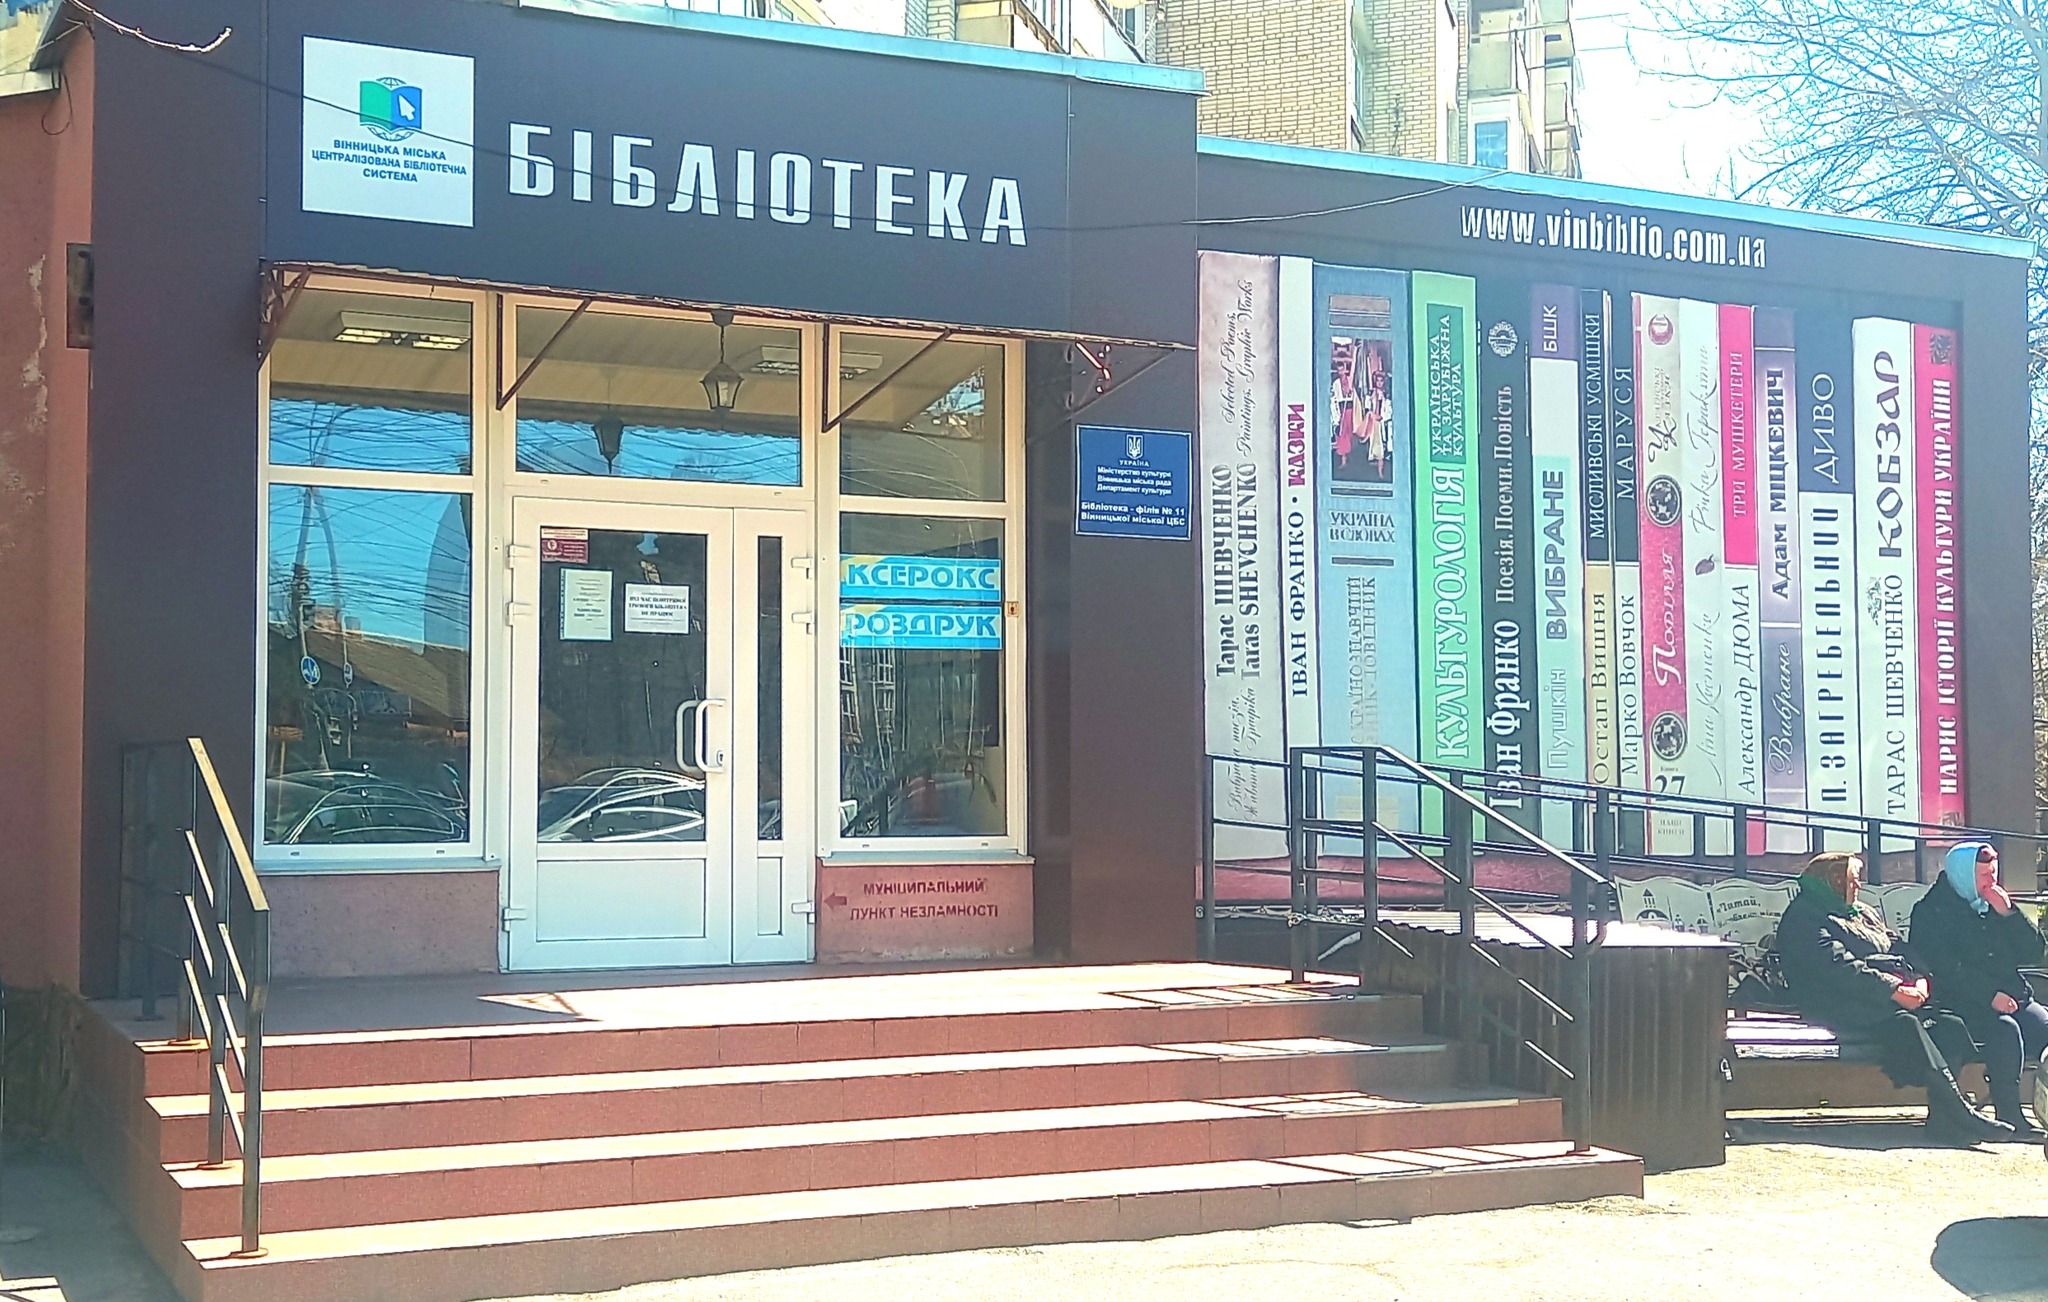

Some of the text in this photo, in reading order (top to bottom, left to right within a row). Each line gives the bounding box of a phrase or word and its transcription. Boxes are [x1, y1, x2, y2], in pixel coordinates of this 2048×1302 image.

[311, 150, 467, 176] ЦЕНТРАЛІЗОВАНА БІБЛІОТЕЧНА
[333, 139, 447, 161] ВІННИЦЬКА МІСЬКА
[363, 168, 418, 183] СИСТЕМА
[507, 120, 1028, 247] БІБЛІОТЕКА
[1460, 205, 1767, 268] www.vinbiblio.com.ua
[1236, 279, 1253, 322] Works
[1543, 304, 1558, 352] БШК
[1220, 363, 1236, 424] Selected
[1237, 328, 1256, 384] Graphic
[1429, 335, 1441, 456] УКРАЇНСЬКА
[1439, 314, 1451, 456] ТА ЗАРУБІЖНА
[1450, 363, 1463, 457] КУЛЬТУРА
[1492, 386, 1513, 460] Повість
[1584, 314, 1605, 540] МИСЛИВСЬКІ УСМІШКИ
[1614, 367, 1635, 500] МАРУСЯ
[1730, 352, 1747, 518] ТРИ МУШКЕТЕРИ
[1812, 373, 1839, 484] ДИВО
[1873, 351, 1903, 557] КОБЗАР
[1081, 502, 1129, 512] Бібліотека
[1135, 504, 1160, 515] філія
[1161, 507, 1173, 515] №
[1174, 508, 1185, 516] 11
[1081, 511, 1186, 527] Вінницької міської ЦБС
[1096, 484, 1141, 493] Департамент
[1097, 466, 1141, 476] Міністерство
[1132, 477, 1155, 485] міська
[1330, 511, 1395, 528] УКРАЇНА
[1766, 368, 1792, 599] Адам МІЦКЕВИЧ
[848, 563, 996, 589] КСЕРОКС
[1211, 464, 1237, 678] Тарас ШЕВЧЕНКО
[1236, 462, 1260, 680] Taras SHEVCHENKO
[1287, 404, 1308, 697] ІВАН ФРАНКО КАЗКИ
[1543, 470, 1567, 640] ВИБРАНЕ
[1930, 379, 1958, 795] НАРИС ІСТОРІЇ КУЛЬТУРИ УКРАЇНИ
[845, 612, 997, 637] РОЗДРУК
[1432, 468, 1468, 759] КУЛЬТУРОЛОГІЯ
[1810, 508, 1847, 802] П. ЗАГРЕБЕЛЬНИЙ
[1485, 619, 1530, 738] Франко
[1544, 668, 1575, 769] Пушкін
[1591, 593, 1611, 785] Остап Вишня
[1619, 594, 1643, 775] Марко Вовчок
[1732, 584, 1758, 795] Александр ДЮМА
[1767, 642, 1800, 775] Вибране
[1884, 574, 1906, 815] ТАРАС ШЕВЧЕНКО
[1488, 743, 1523, 809] Іван
[1655, 774, 1686, 801] 27
[850, 904, 999, 921] ПУНКТ НЕЗЛАМНОСТІ
[863, 878, 987, 896] МУНІЦИПАЛЬНИЙ
